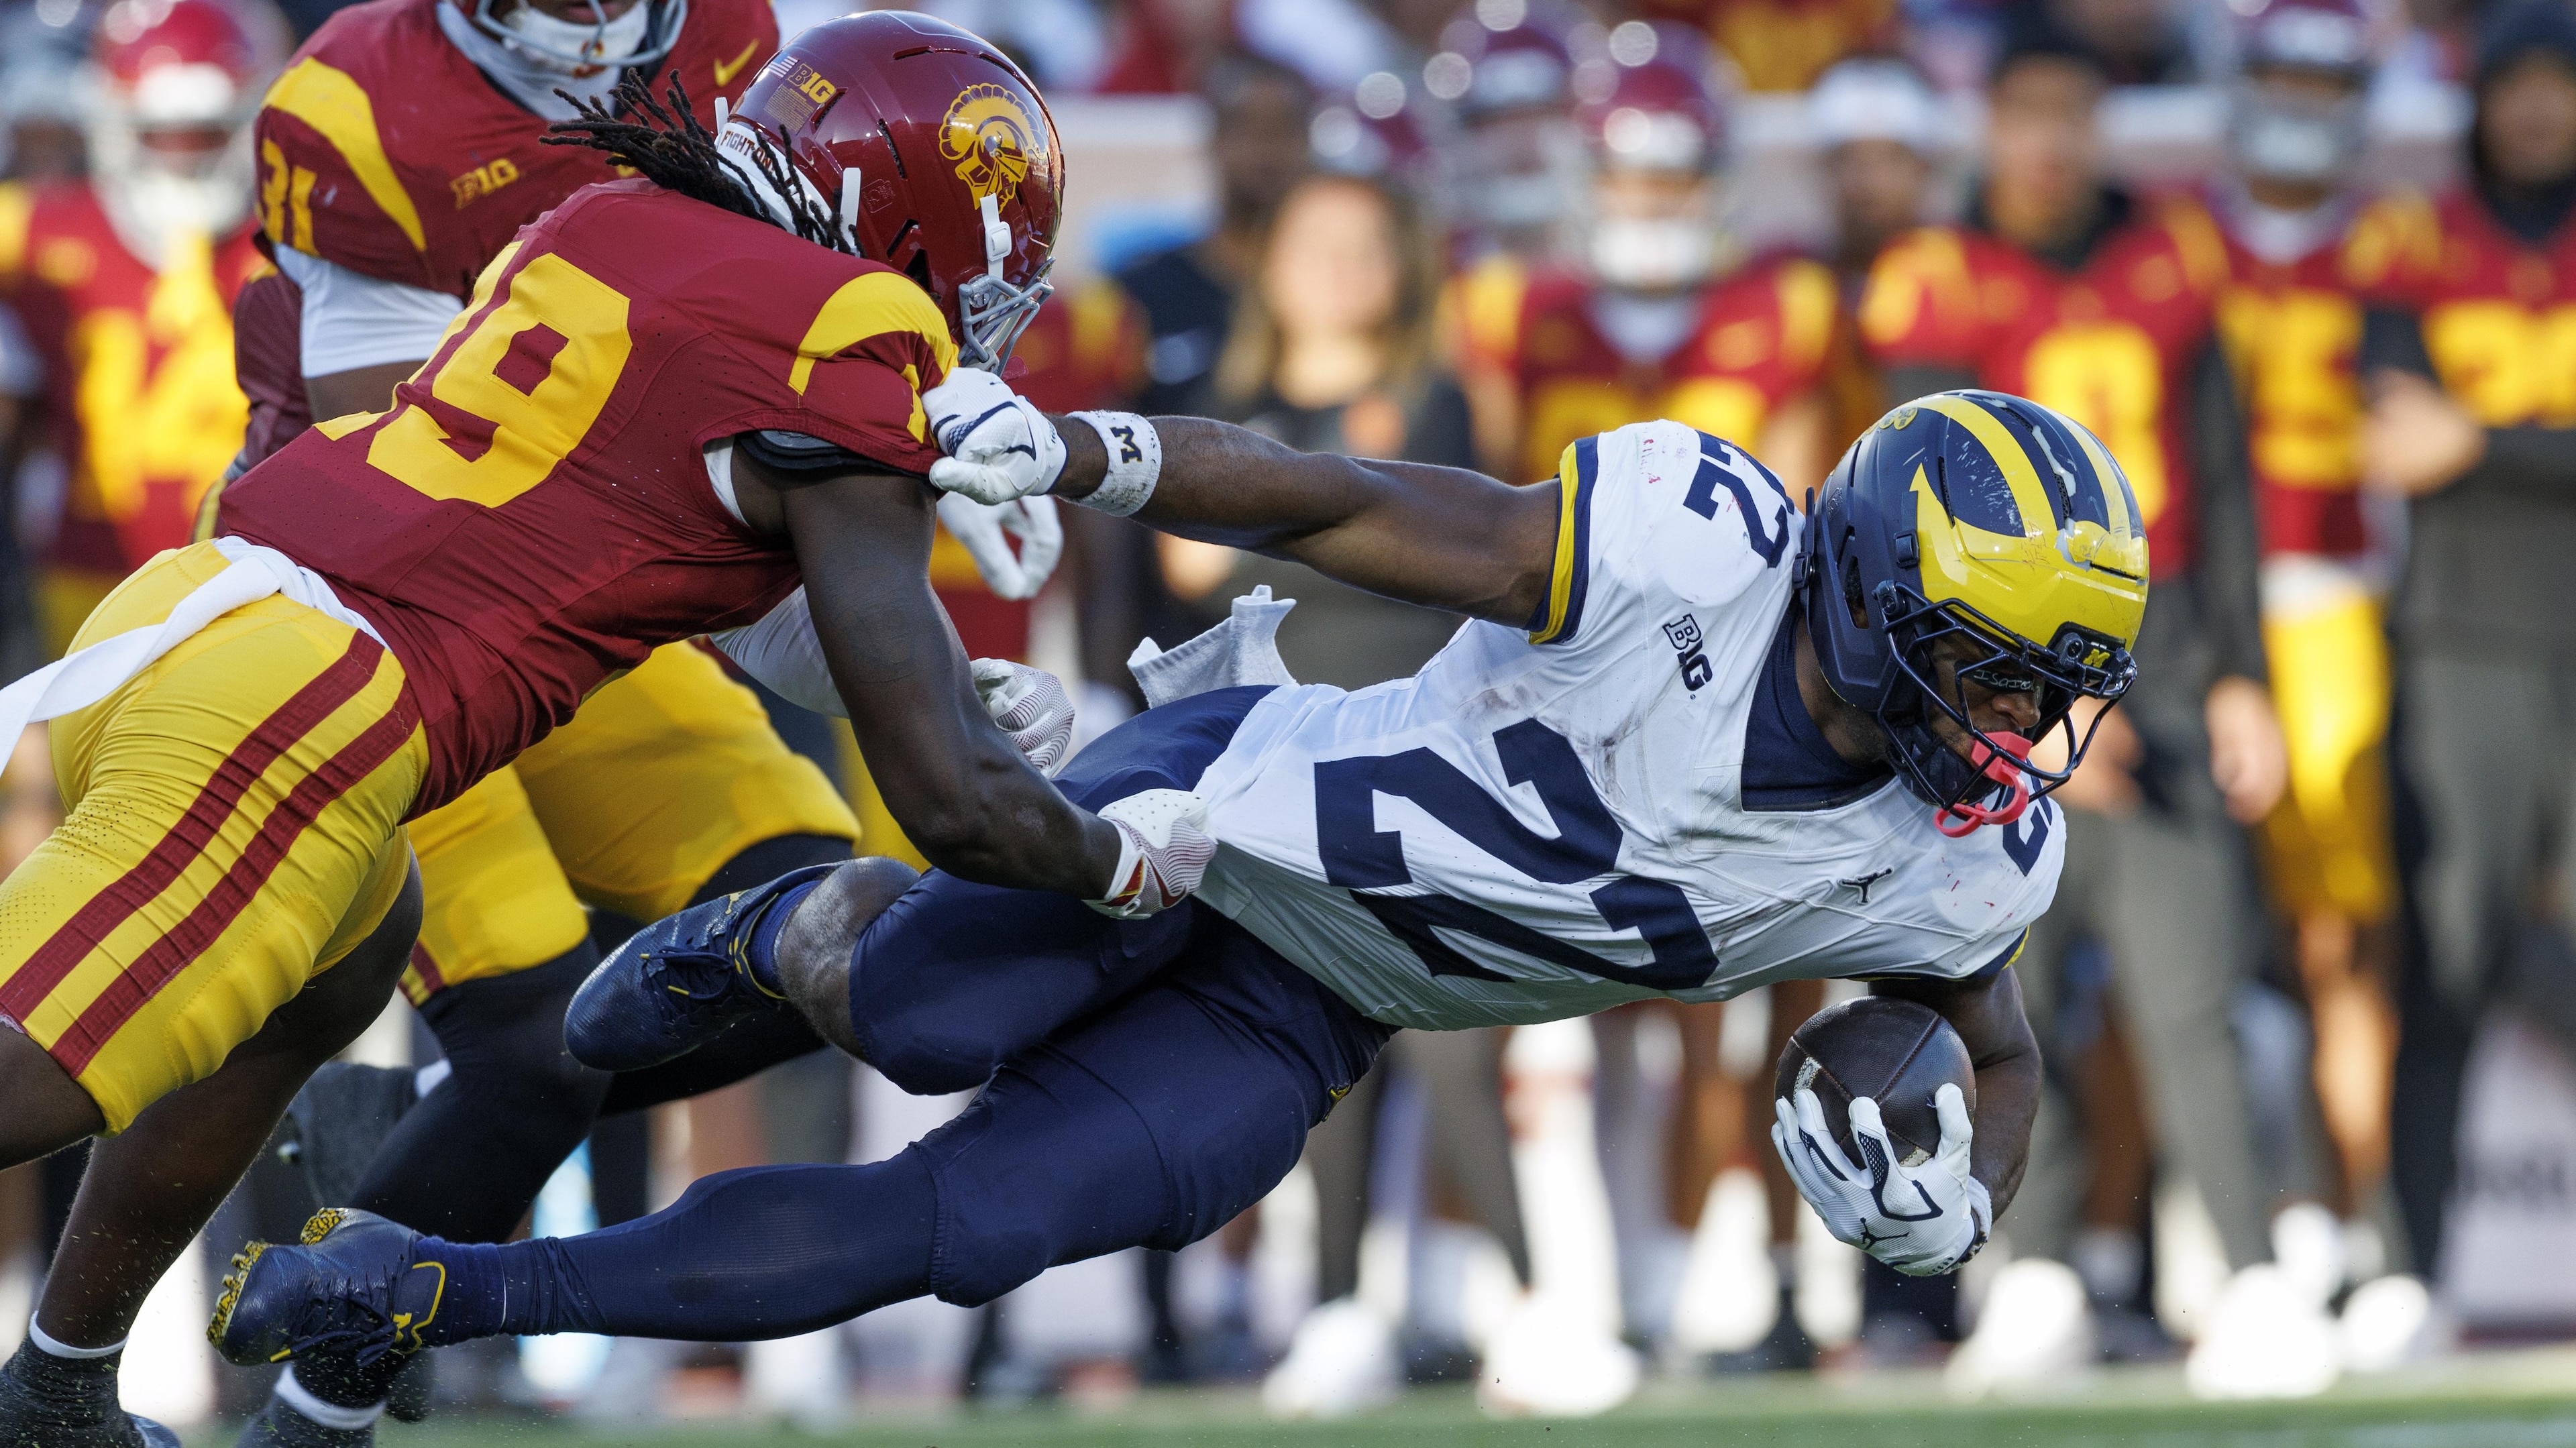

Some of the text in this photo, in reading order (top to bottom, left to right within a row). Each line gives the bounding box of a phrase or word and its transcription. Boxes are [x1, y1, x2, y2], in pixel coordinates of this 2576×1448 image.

[256, 137, 321, 256] 31
[720, 129, 755, 157] FIGHT
[313, 239, 633, 508] 19
[1109, 425, 1142, 464] M
[1682, 429, 1796, 569] 22
[2083, 648, 2110, 669] M
[1313, 716, 1720, 991] 22
